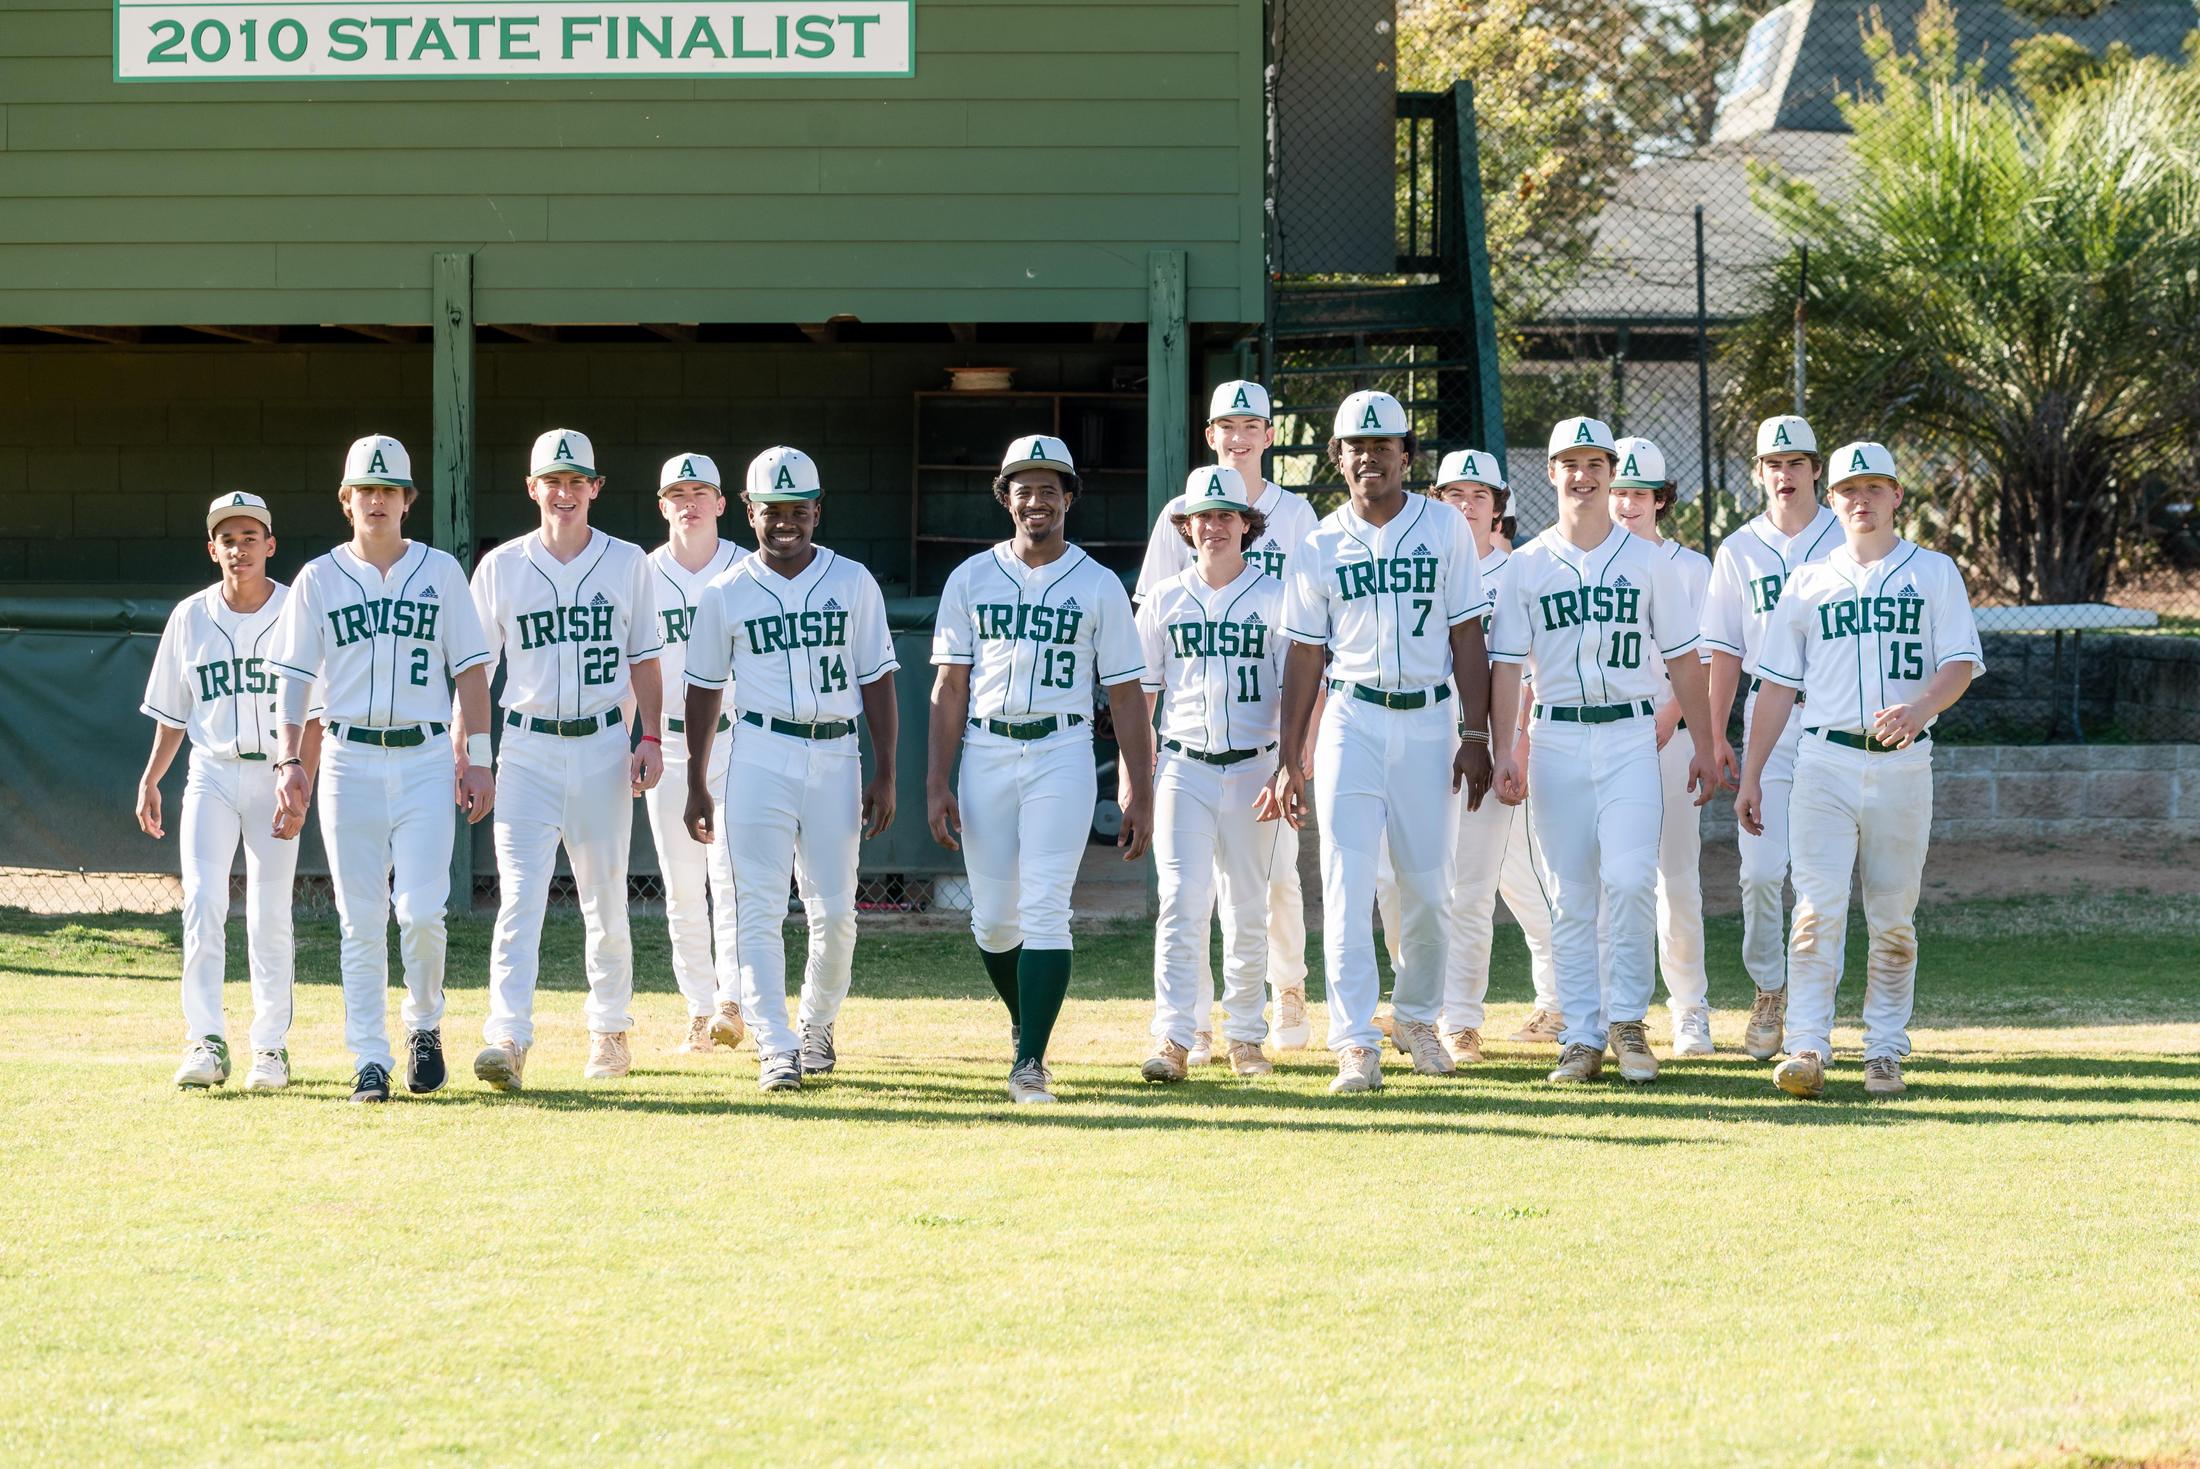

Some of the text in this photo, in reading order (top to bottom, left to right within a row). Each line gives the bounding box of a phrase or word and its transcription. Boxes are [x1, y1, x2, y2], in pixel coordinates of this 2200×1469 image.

[147, 13, 881, 64] 2010 STATE FINALIST
[1232, 388, 1251, 409] A
[1361, 406, 1382, 429] A
[554, 439, 574, 461] A
[1031, 441, 1047, 460] A
[1575, 423, 1595, 444] A
[1773, 425, 1792, 447] A
[369, 450, 389, 474] A
[678, 459, 697, 478] A
[775, 465, 796, 490] A
[1461, 455, 1480, 476] A
[1621, 454, 1641, 477] A
[1849, 450, 1870, 473] A
[232, 493, 246, 507] A
[1205, 474, 1226, 497] A
[1335, 556, 1439, 602] IRISH
[328, 597, 440, 647] IRISH
[516, 604, 615, 650] IRISH
[976, 603, 1084, 645] IRISH
[1412, 598, 1433, 637] 7
[1539, 584, 1641, 632] IRISH
[1817, 596, 1925, 641] IRISH
[744, 609, 849, 655] IRISH
[1168, 621, 1268, 660] IRISH
[1606, 631, 1642, 669] 10
[410, 647, 429, 687] 2
[583, 646, 620, 686] 22
[818, 654, 849, 694] 14
[1040, 647, 1076, 690] 13
[1887, 641, 1924, 681] 15
[1237, 664, 1262, 703] 11
